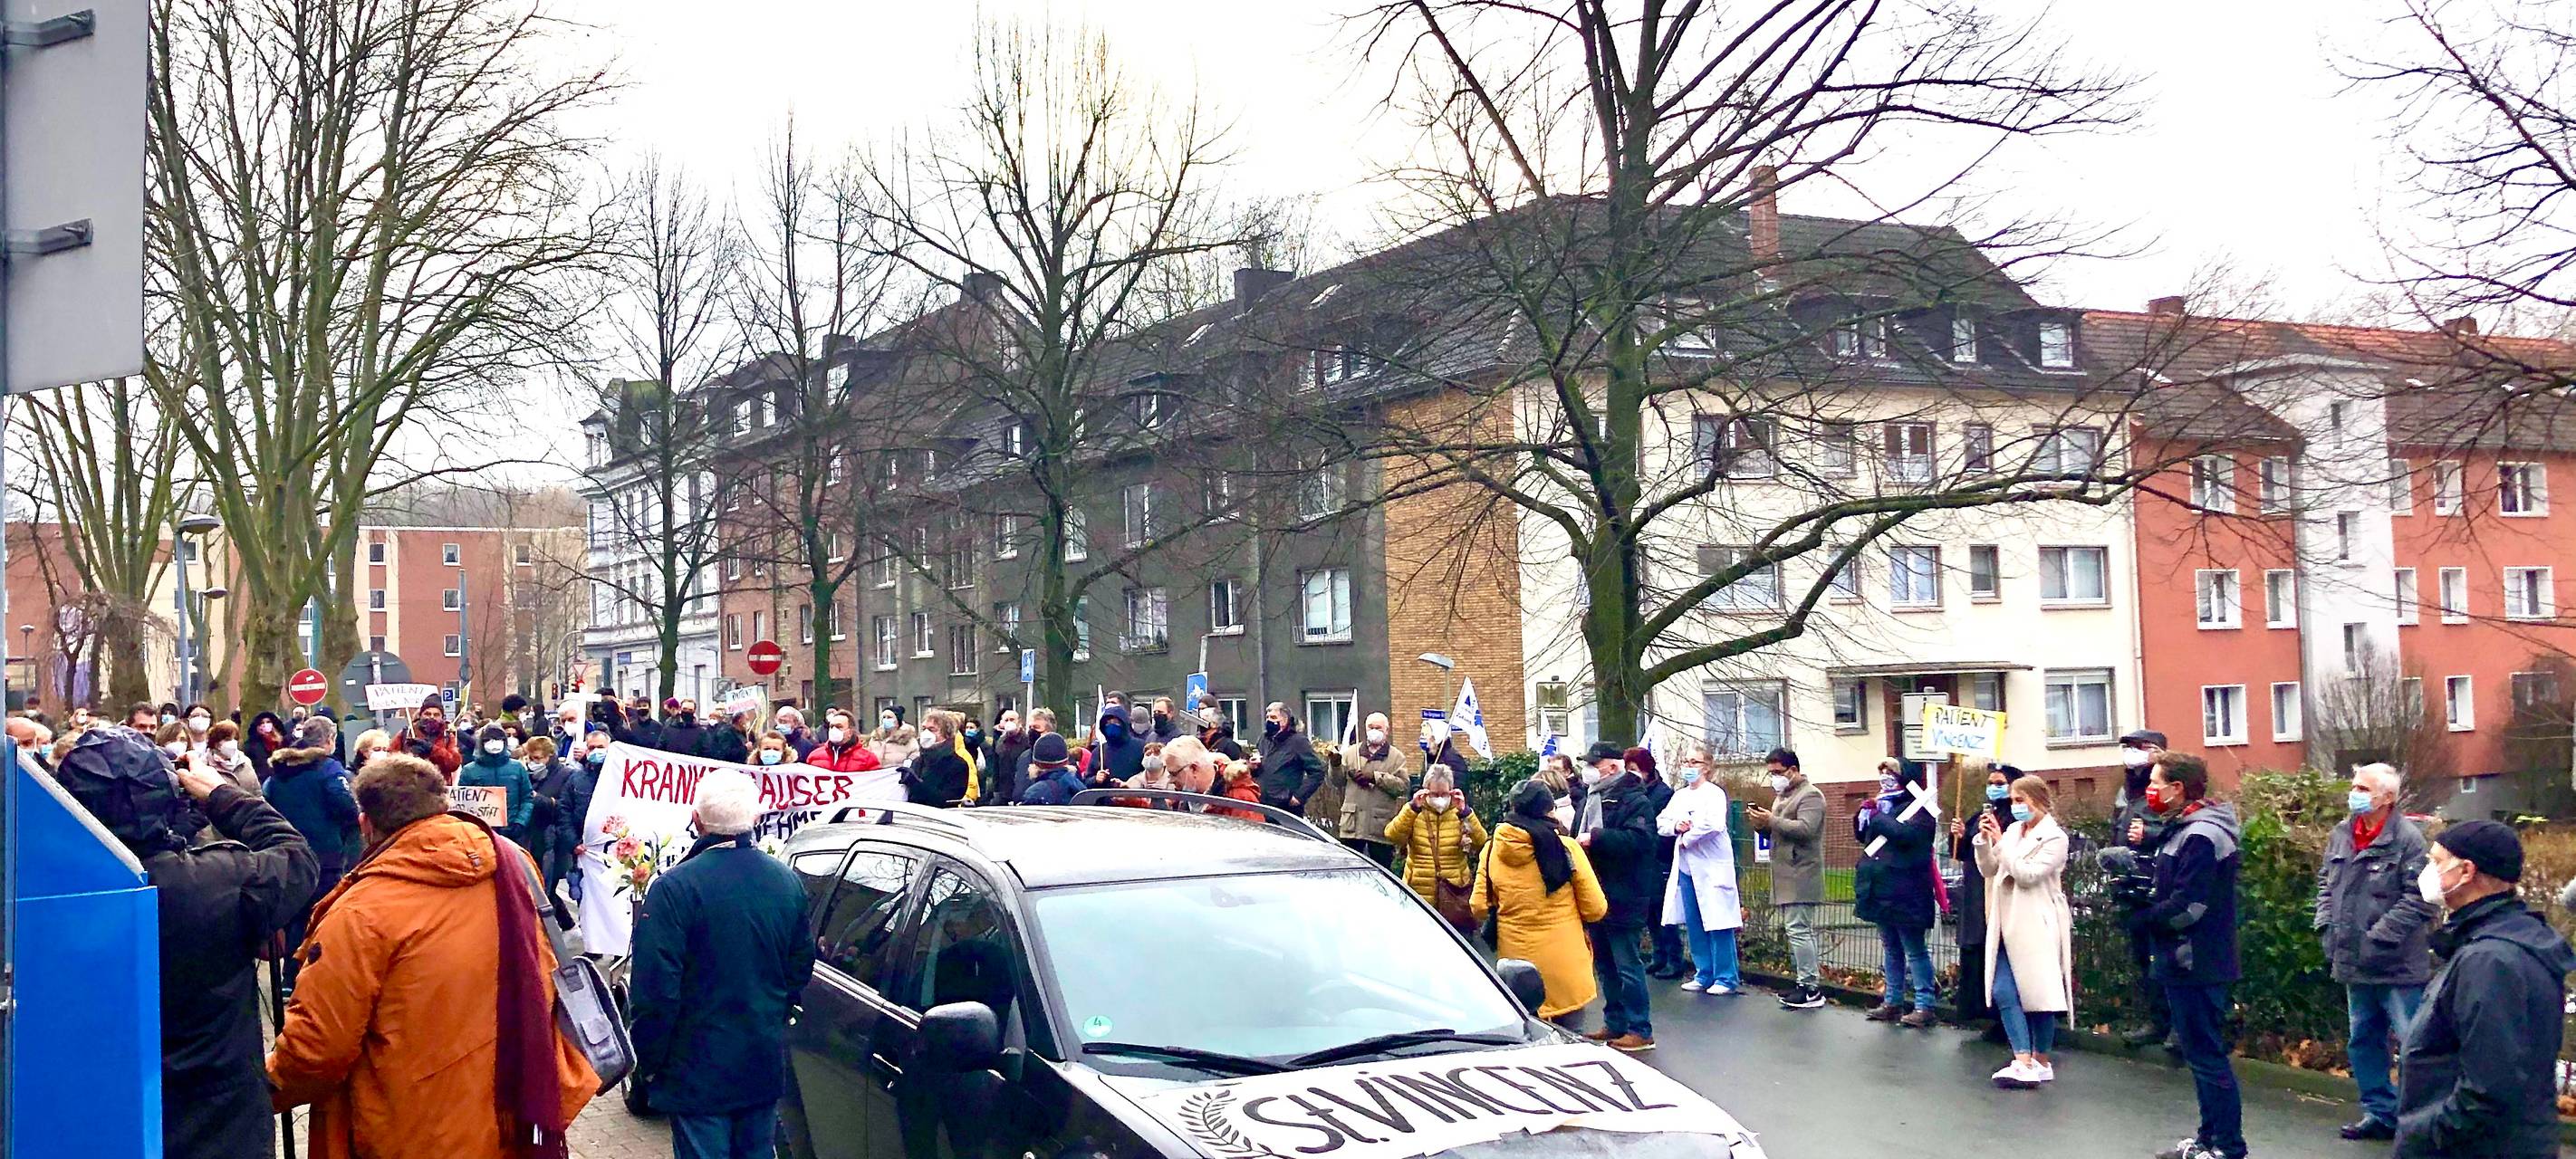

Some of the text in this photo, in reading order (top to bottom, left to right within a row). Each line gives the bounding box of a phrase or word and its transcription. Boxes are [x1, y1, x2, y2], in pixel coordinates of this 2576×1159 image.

[1936, 706, 1996, 728] PATIENT
[449, 787, 495, 802] ATIENT
[621, 758, 853, 810] KRANKÄUSER
